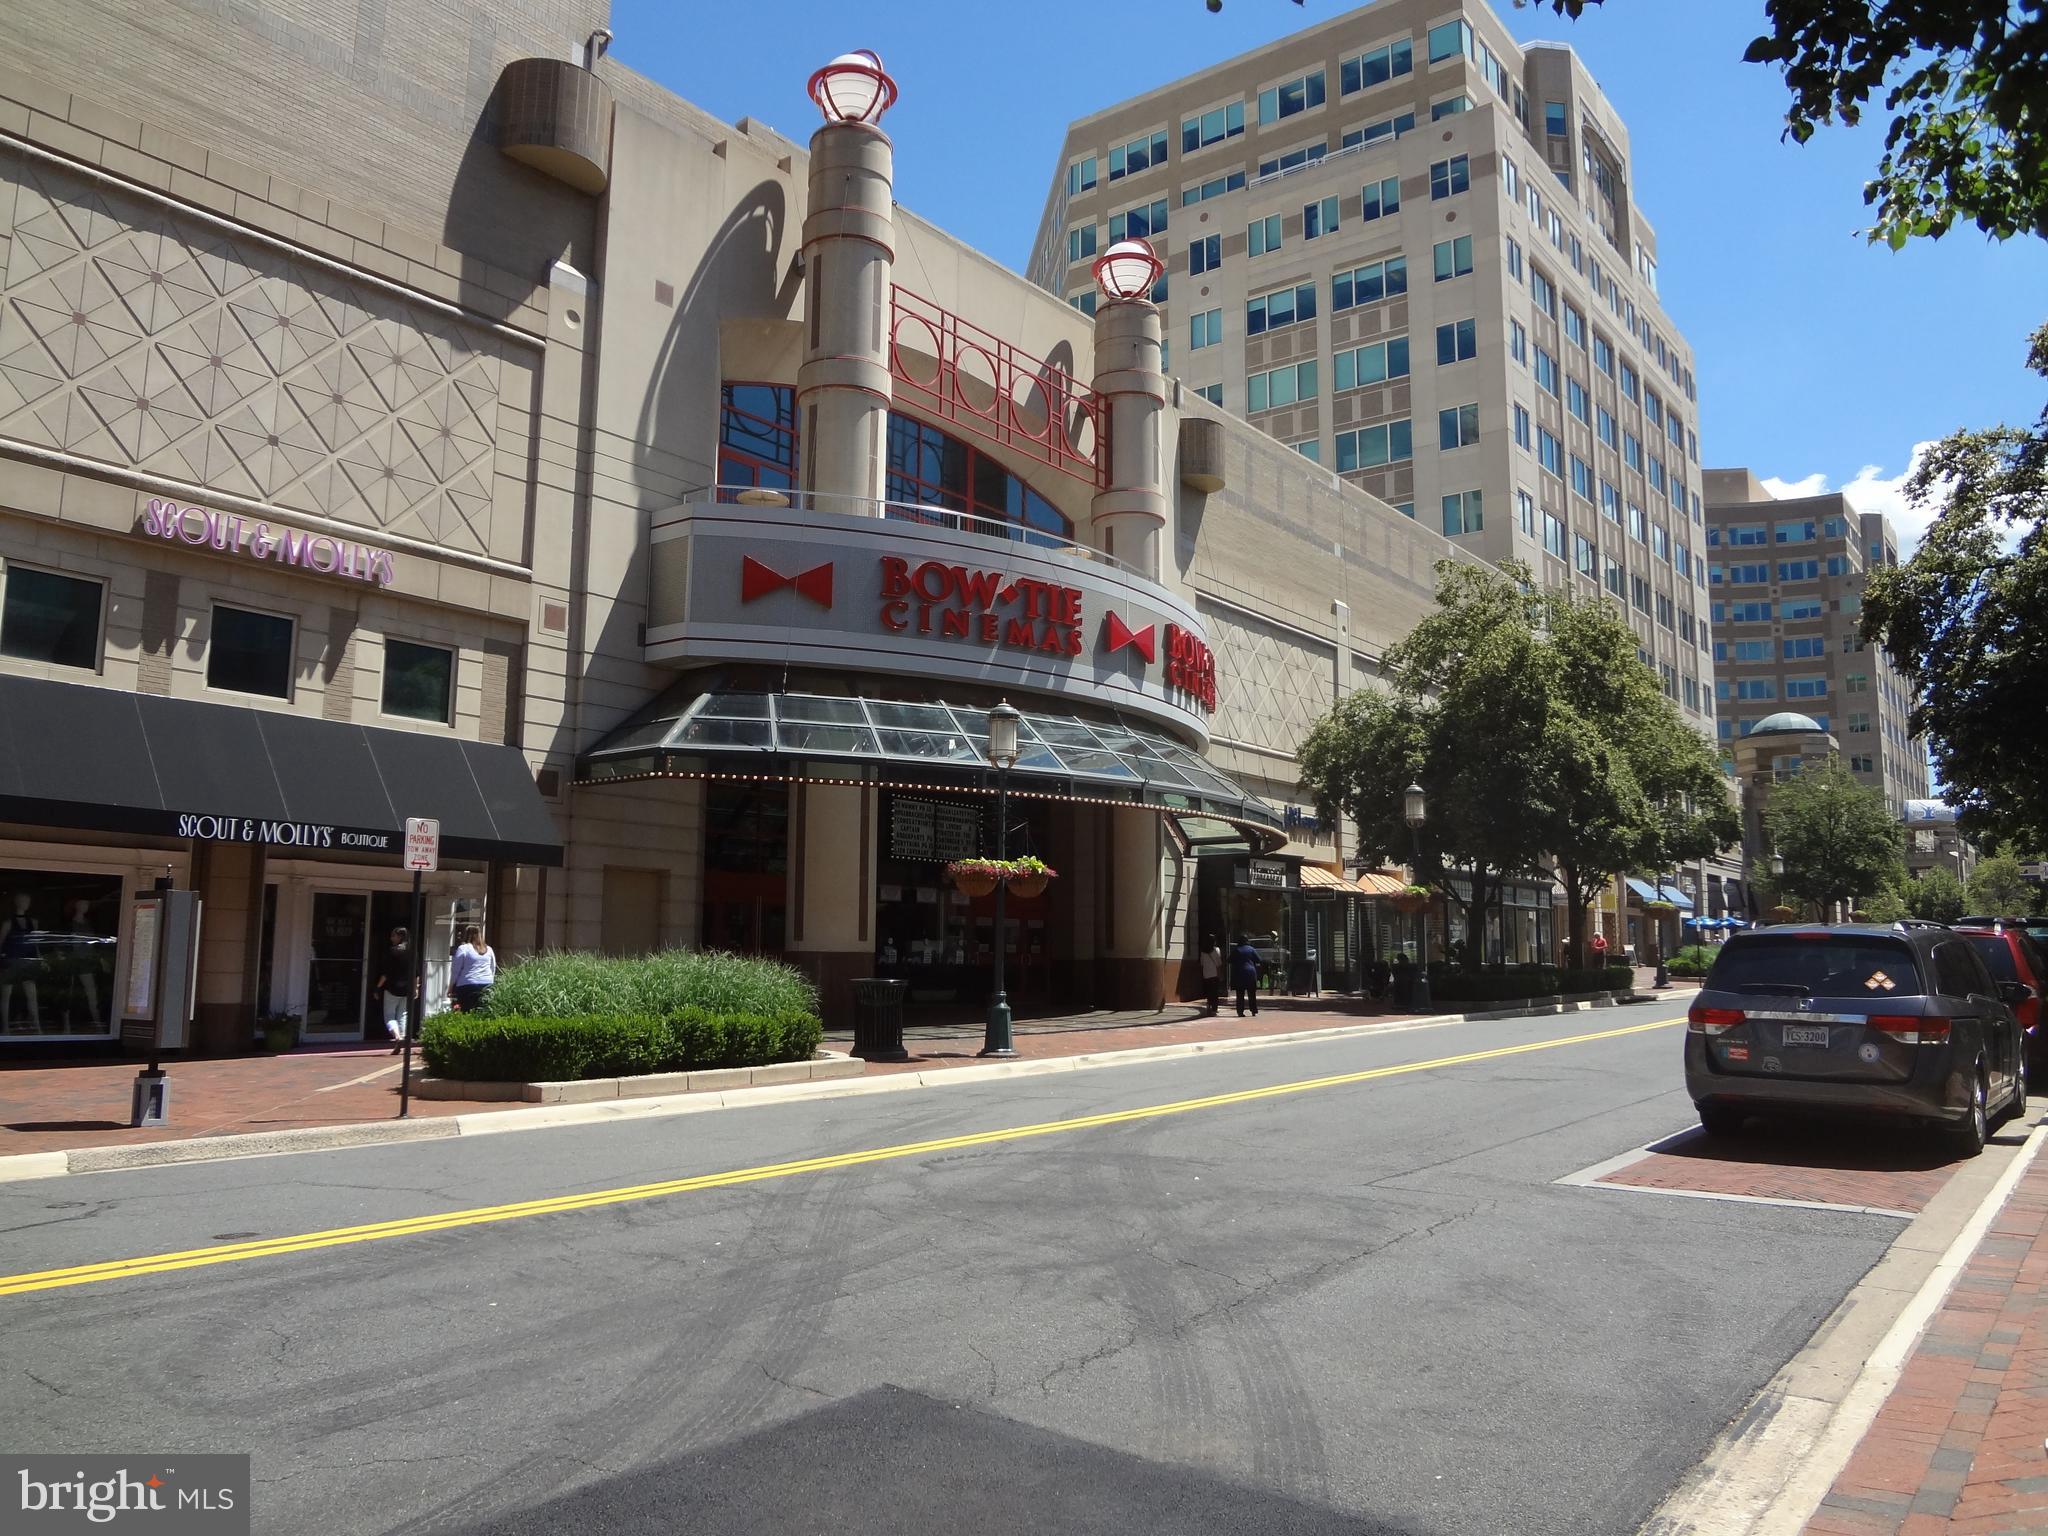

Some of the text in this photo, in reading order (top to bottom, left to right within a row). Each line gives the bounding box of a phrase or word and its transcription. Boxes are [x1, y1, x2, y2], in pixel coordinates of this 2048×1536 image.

[143, 498, 394, 585] SCOUT & MOLLY'S
[880, 601, 1083, 656] CINEMAS
[178, 814, 389, 848] SCOUT & MOLLY'S BOUTIQUE
[408, 834, 435, 846] PARKING
[416, 822, 429, 834] NO
